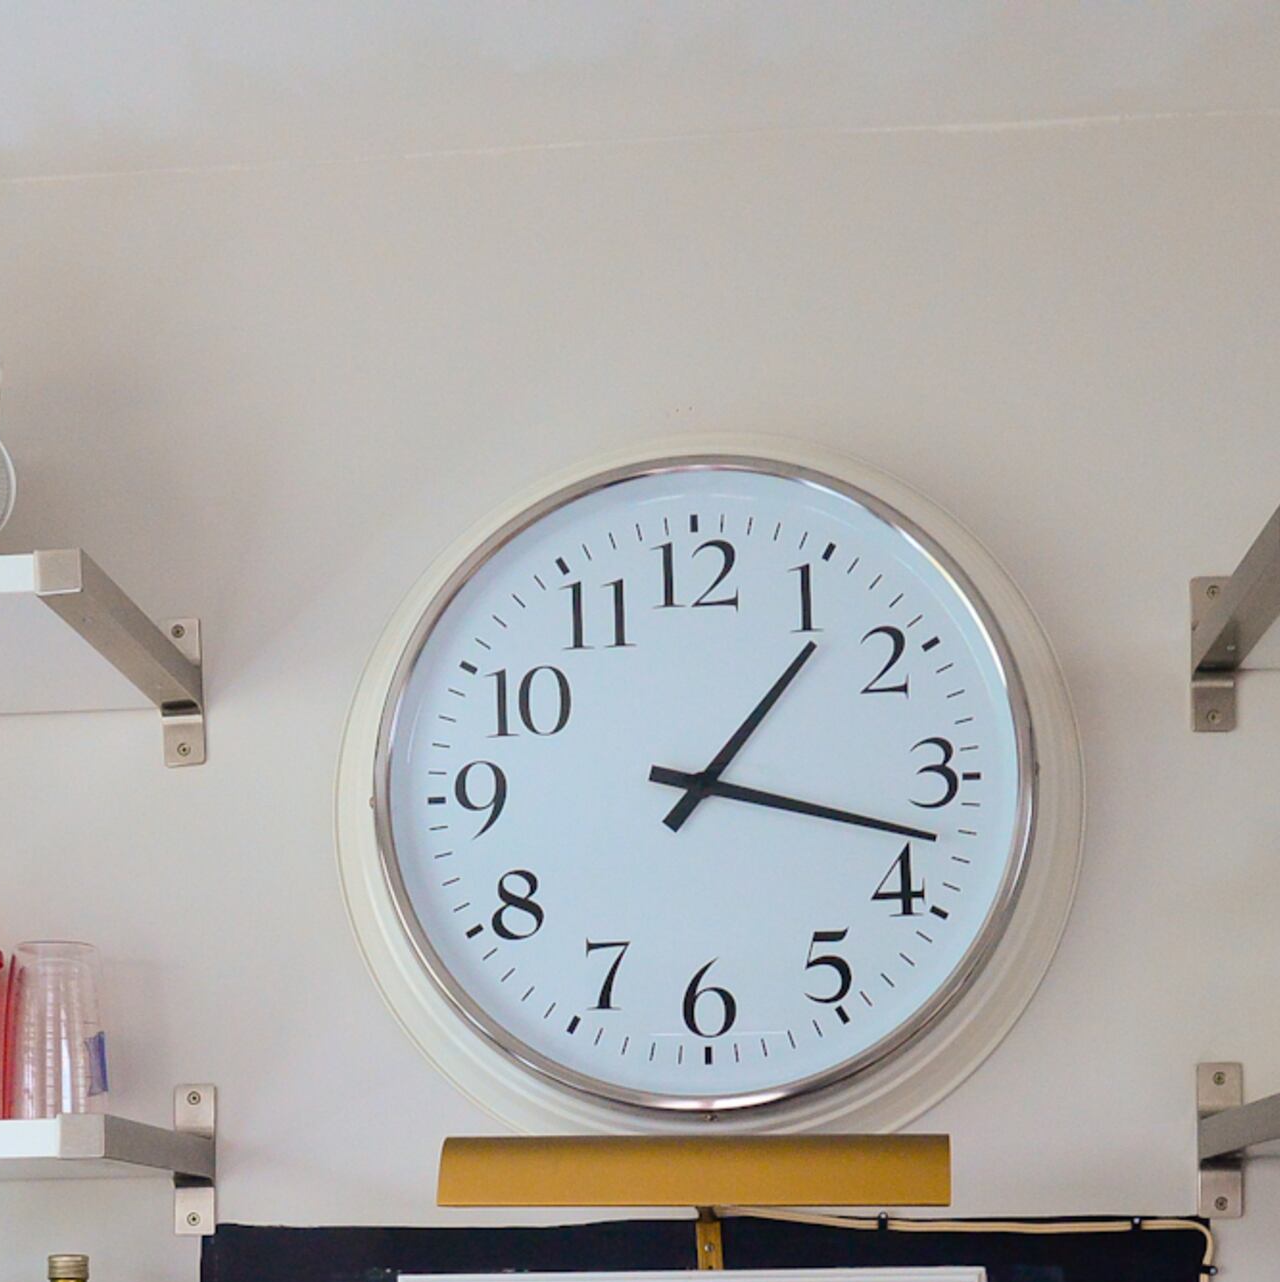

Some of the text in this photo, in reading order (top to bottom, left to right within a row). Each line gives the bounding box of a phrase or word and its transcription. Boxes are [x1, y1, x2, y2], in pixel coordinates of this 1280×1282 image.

[651, 540, 739, 612] 12
[787, 563, 823, 632] 1
[560, 578, 636, 649] 11
[860, 625, 909, 699] 2
[485, 665, 572, 737] 10
[454, 760, 508, 839] 9
[908, 737, 959, 808] 3
[491, 869, 545, 940] 8
[871, 842, 926, 916] 4
[586, 937, 631, 1010] 7
[682, 957, 737, 1038] 6
[804, 927, 853, 1004] 5
